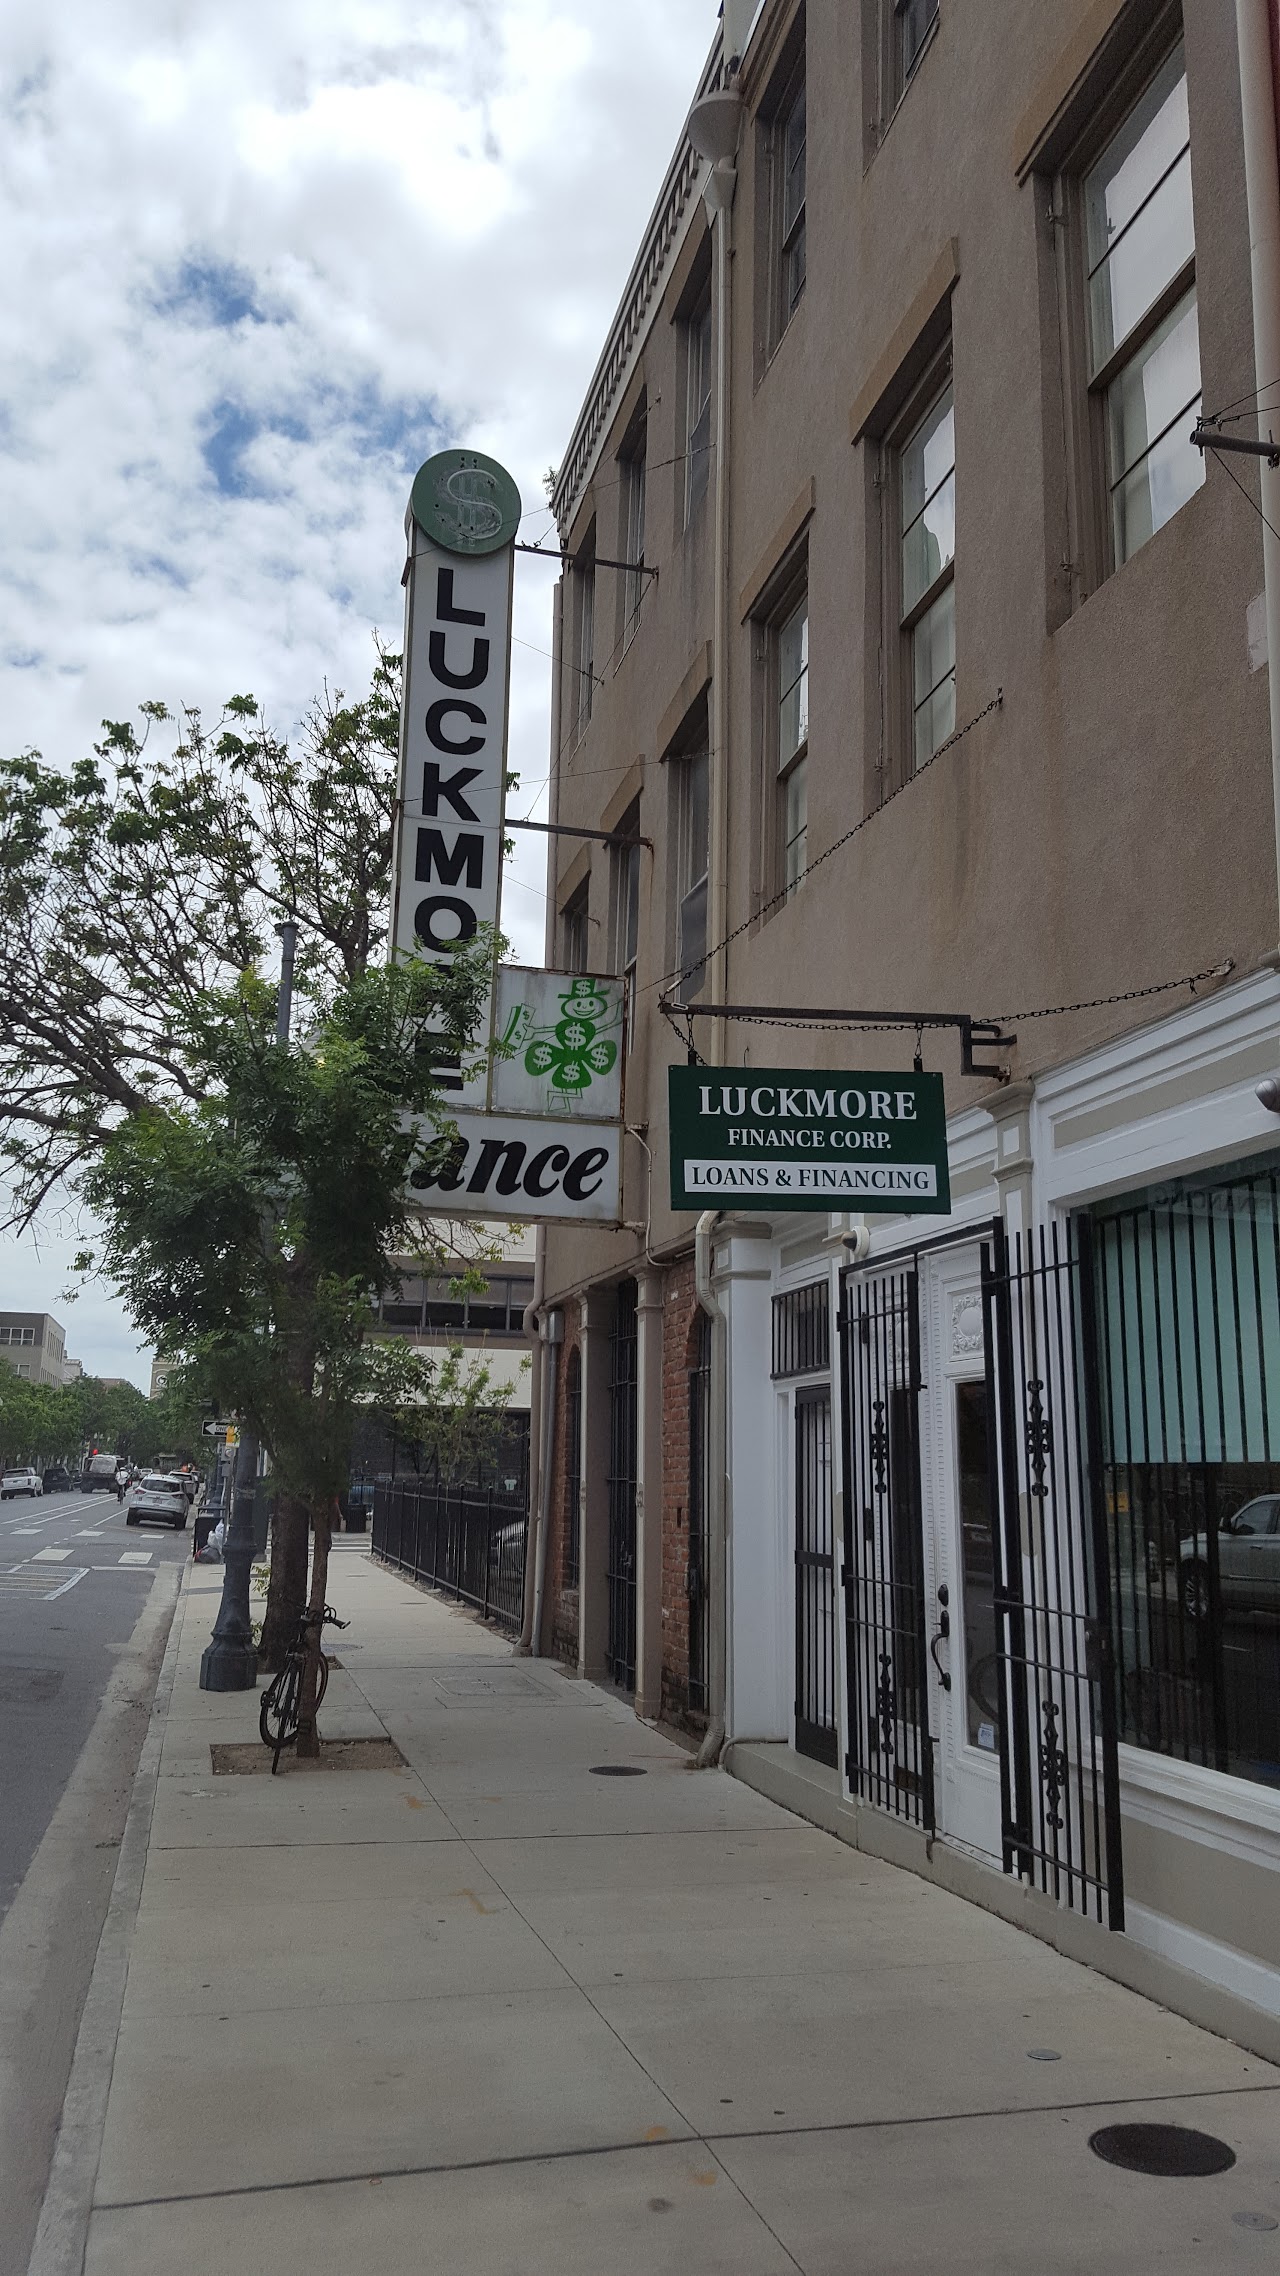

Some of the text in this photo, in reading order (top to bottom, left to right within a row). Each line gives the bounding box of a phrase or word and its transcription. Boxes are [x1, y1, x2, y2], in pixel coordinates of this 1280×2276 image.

[412, 566, 490, 1091] LUCKMOE
[698, 1086, 918, 1120] LUCKMORE
[727, 1128, 892, 1149] FINANCE CORP.
[400, 1133, 610, 1202] ance
[692, 1166, 930, 1190] LOANS & FINANCING
